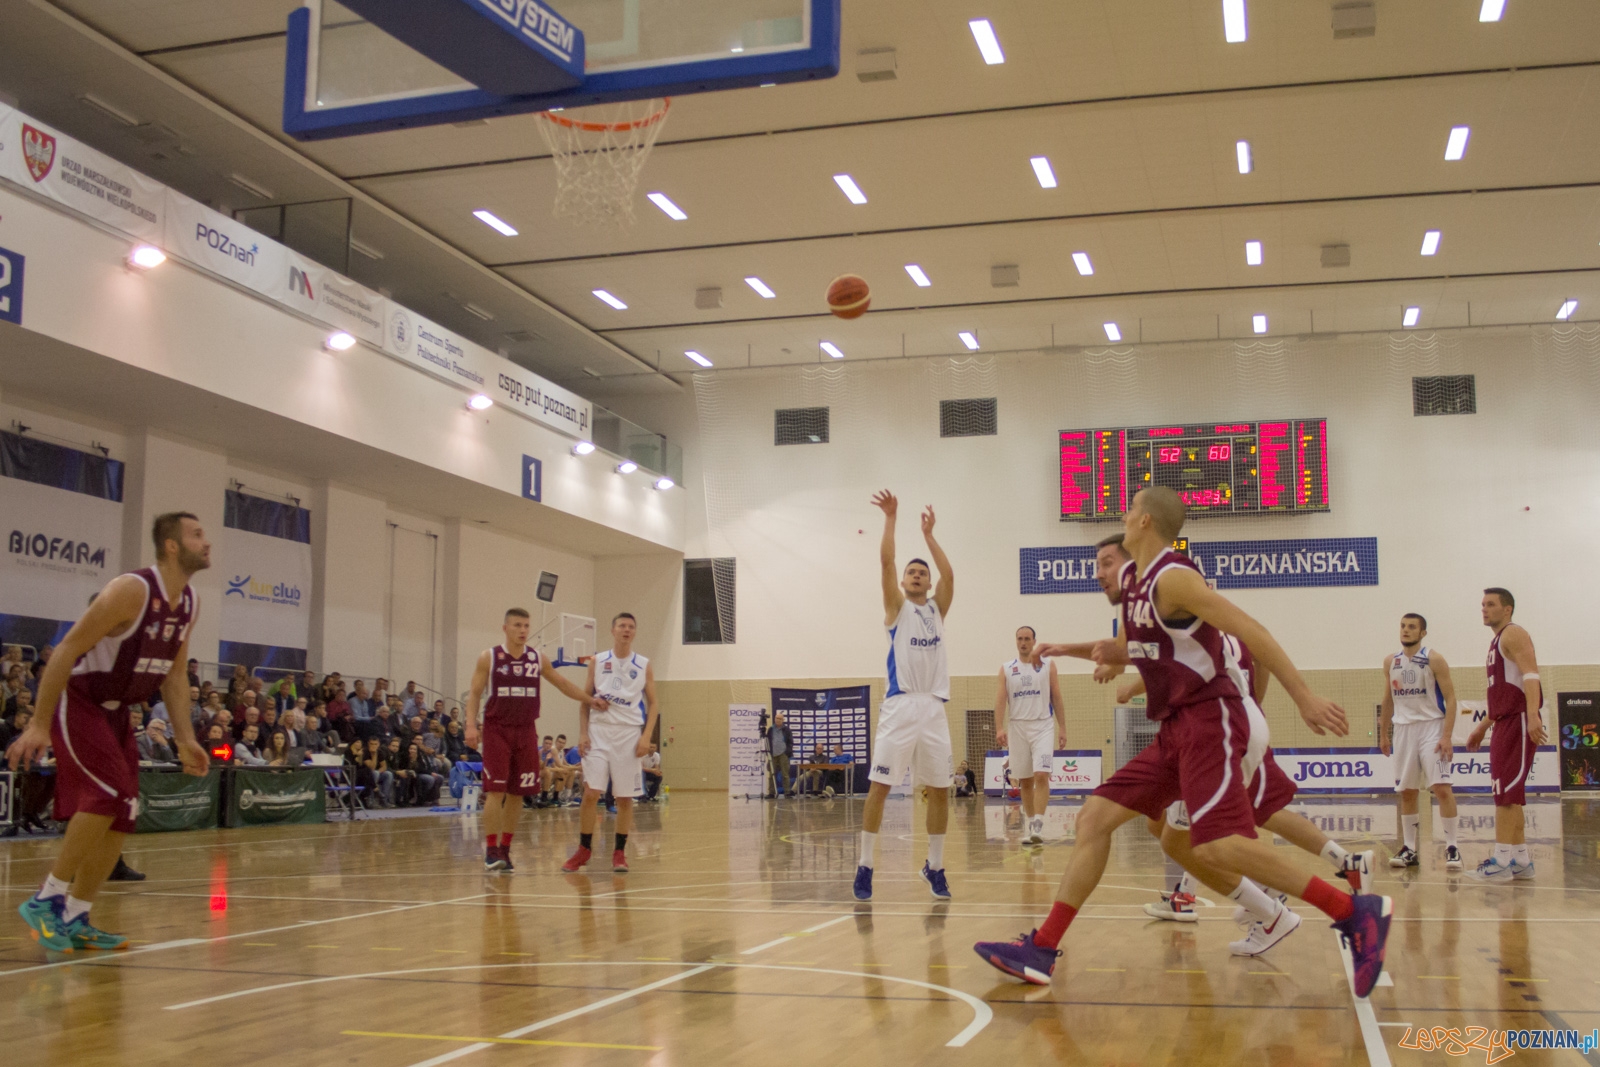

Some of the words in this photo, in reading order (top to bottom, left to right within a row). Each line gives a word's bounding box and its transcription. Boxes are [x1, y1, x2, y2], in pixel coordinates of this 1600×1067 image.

[418, 325, 443, 347] Centrum
[445, 338, 464, 358] Sportu
[498, 373, 588, 431] cspp.put.poznan.pl
[1160, 447, 1181, 463] 52
[1208, 445, 1230, 461] 60
[528, 462, 536, 496] 1
[9, 530, 105, 568] BIOFARM
[1215, 548, 1360, 576] POZNAŃSKA
[1133, 599, 1154, 628] 44
[524, 662, 539, 678] 22
[1401, 669, 1416, 684] 10
[1562, 724, 1599, 750] 35
[520, 772, 535, 788] 22
[1049, 774, 1091, 783] CYMES
[1293, 760, 1374, 782] Joma
